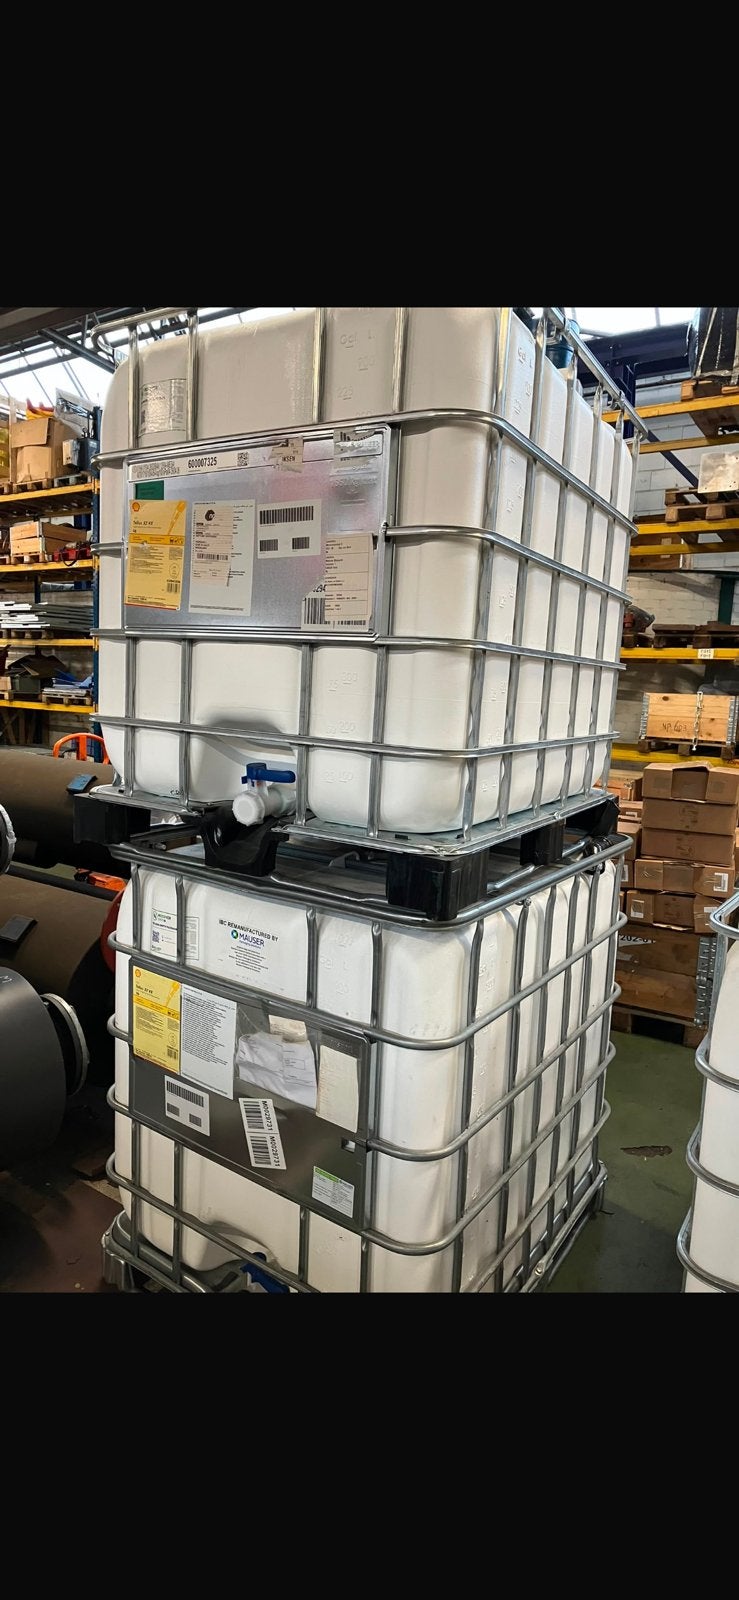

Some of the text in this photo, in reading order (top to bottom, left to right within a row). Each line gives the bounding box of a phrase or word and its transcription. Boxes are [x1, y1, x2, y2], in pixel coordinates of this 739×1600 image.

[187, 456, 218, 469] 600007325
[227, 921, 271, 940] REMANUFACTURED
[239, 932, 265, 947] MAUSER
[261, 1100, 273, 1131] M0029731
[269, 1135, 281, 1167] M0029731
